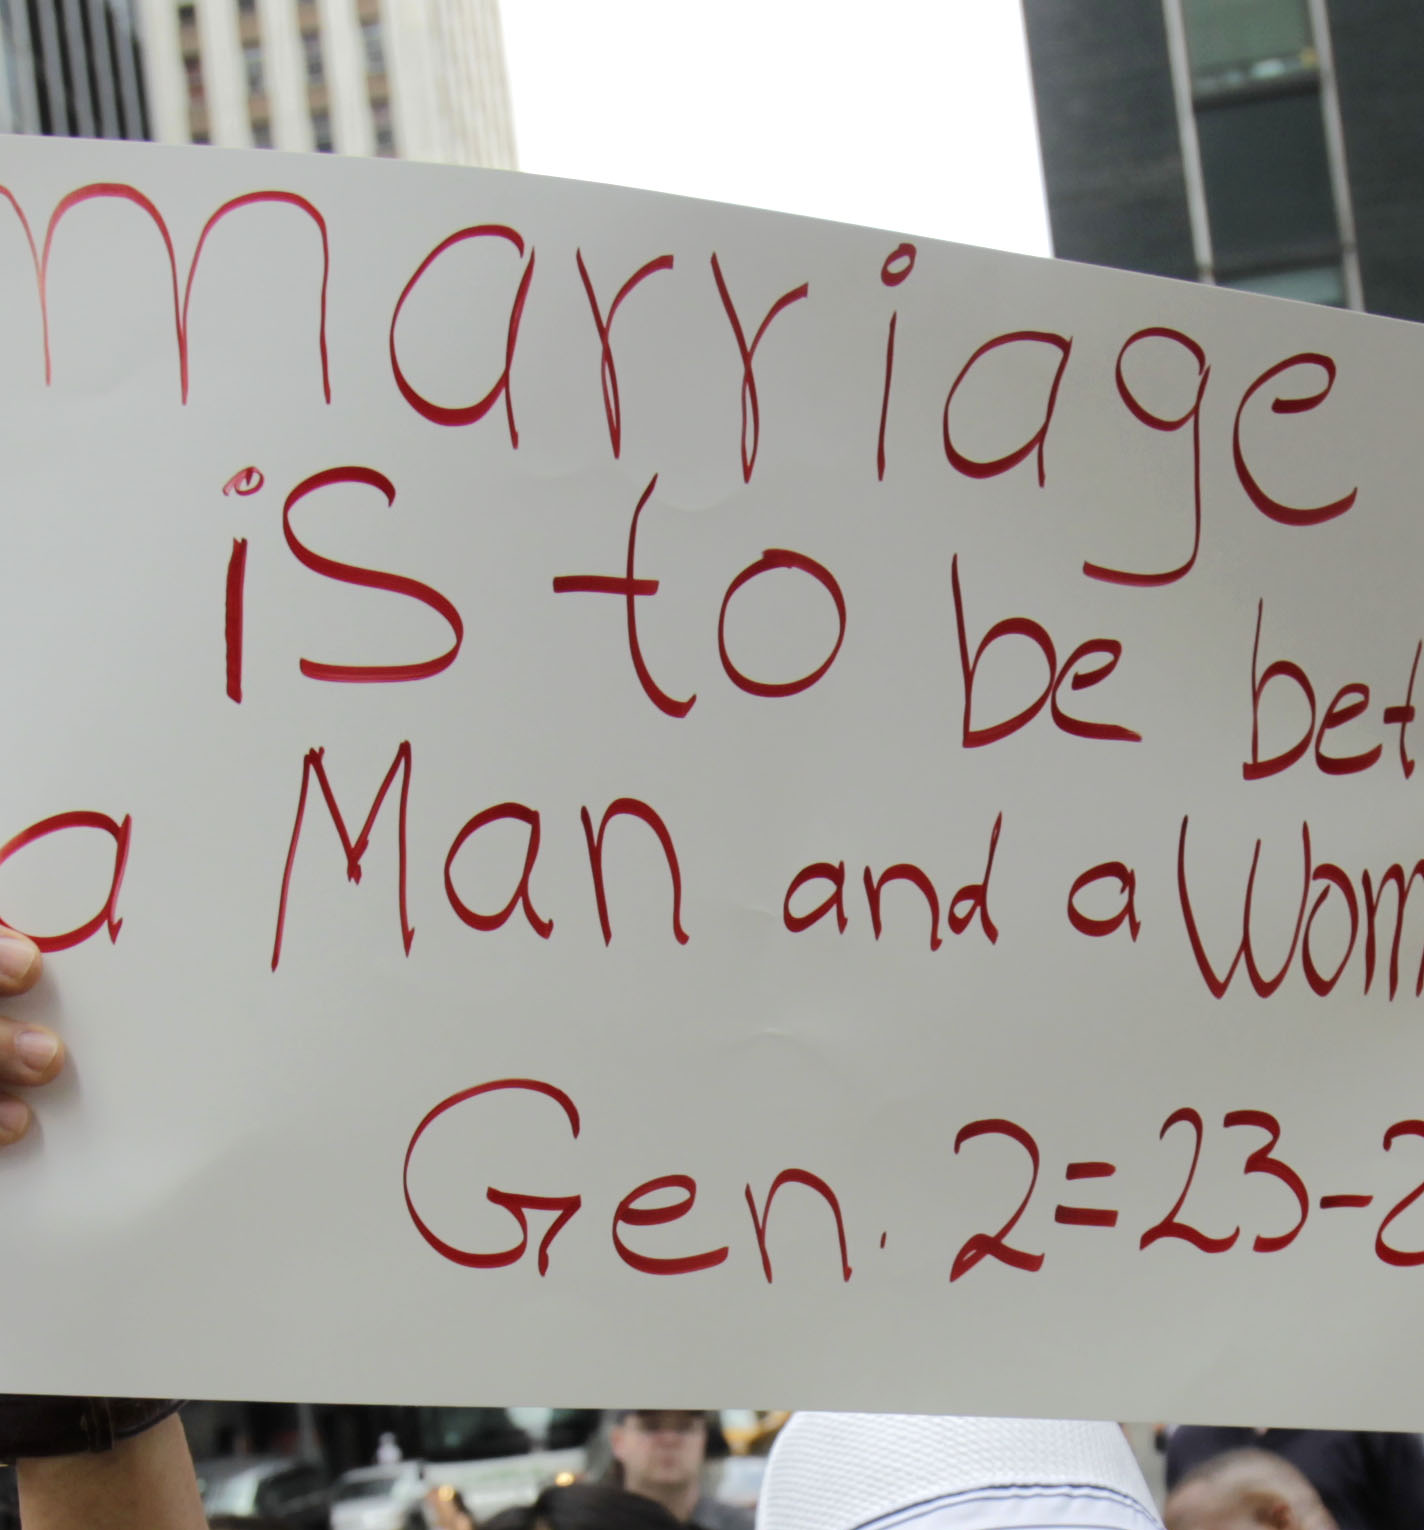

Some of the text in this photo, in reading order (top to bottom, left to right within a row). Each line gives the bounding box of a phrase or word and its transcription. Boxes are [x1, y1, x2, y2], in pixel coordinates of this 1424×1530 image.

[552, 473, 848, 719] to
[951, 553, 1143, 750] be
[271, 740, 691, 972] Man
[783, 811, 1003, 952] and
[1066, 860, 1142, 942] a
[403, 1077, 887, 1284] Gen.
